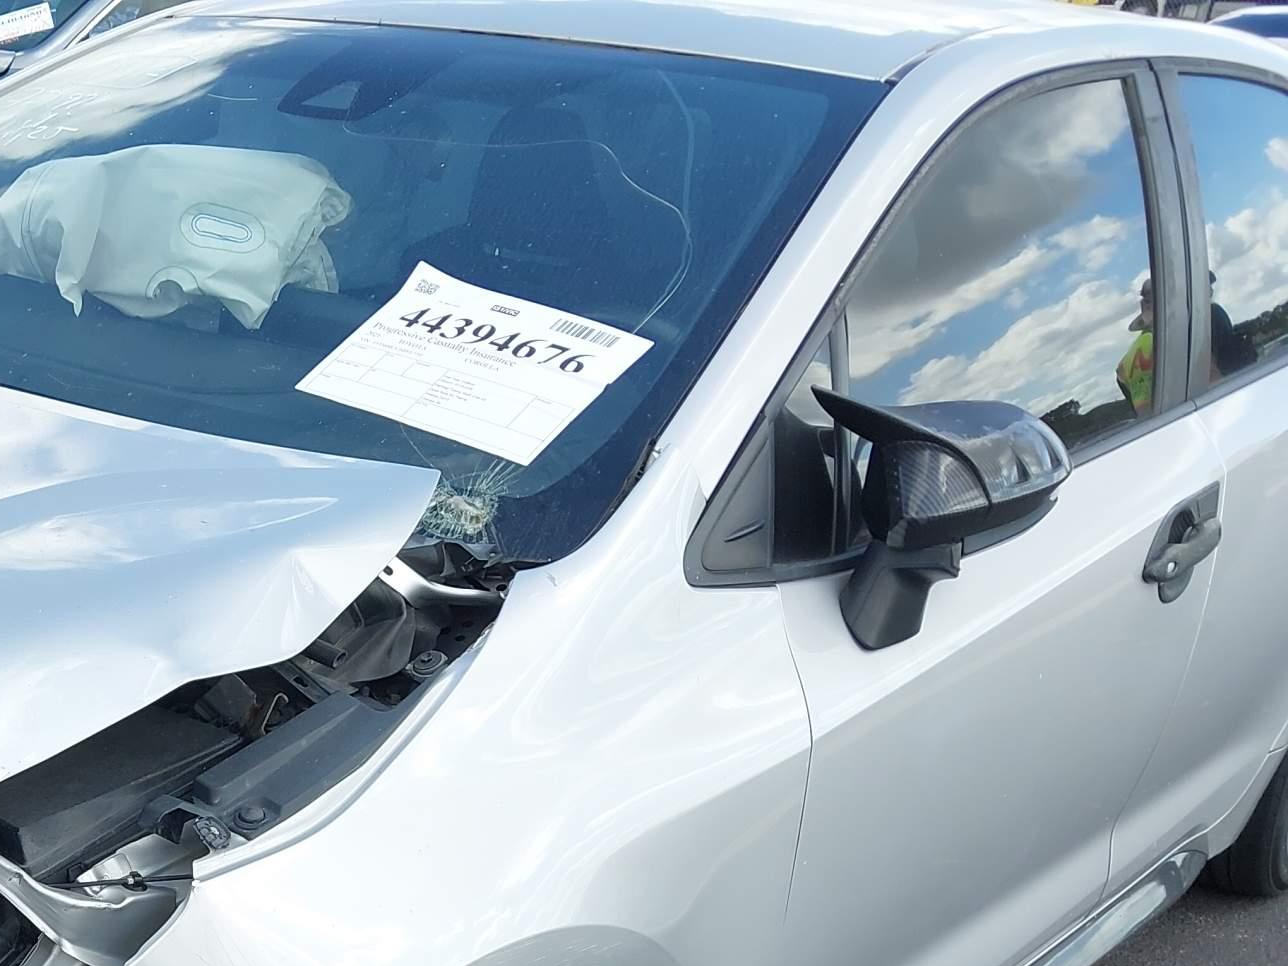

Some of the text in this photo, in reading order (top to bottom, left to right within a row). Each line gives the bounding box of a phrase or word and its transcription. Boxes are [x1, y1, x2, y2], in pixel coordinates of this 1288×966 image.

[372, 321, 426, 341] Progressive
[426, 336, 468, 354] Casualty
[470, 347, 516, 367] Insurance
[399, 308, 594, 373] 44394676
